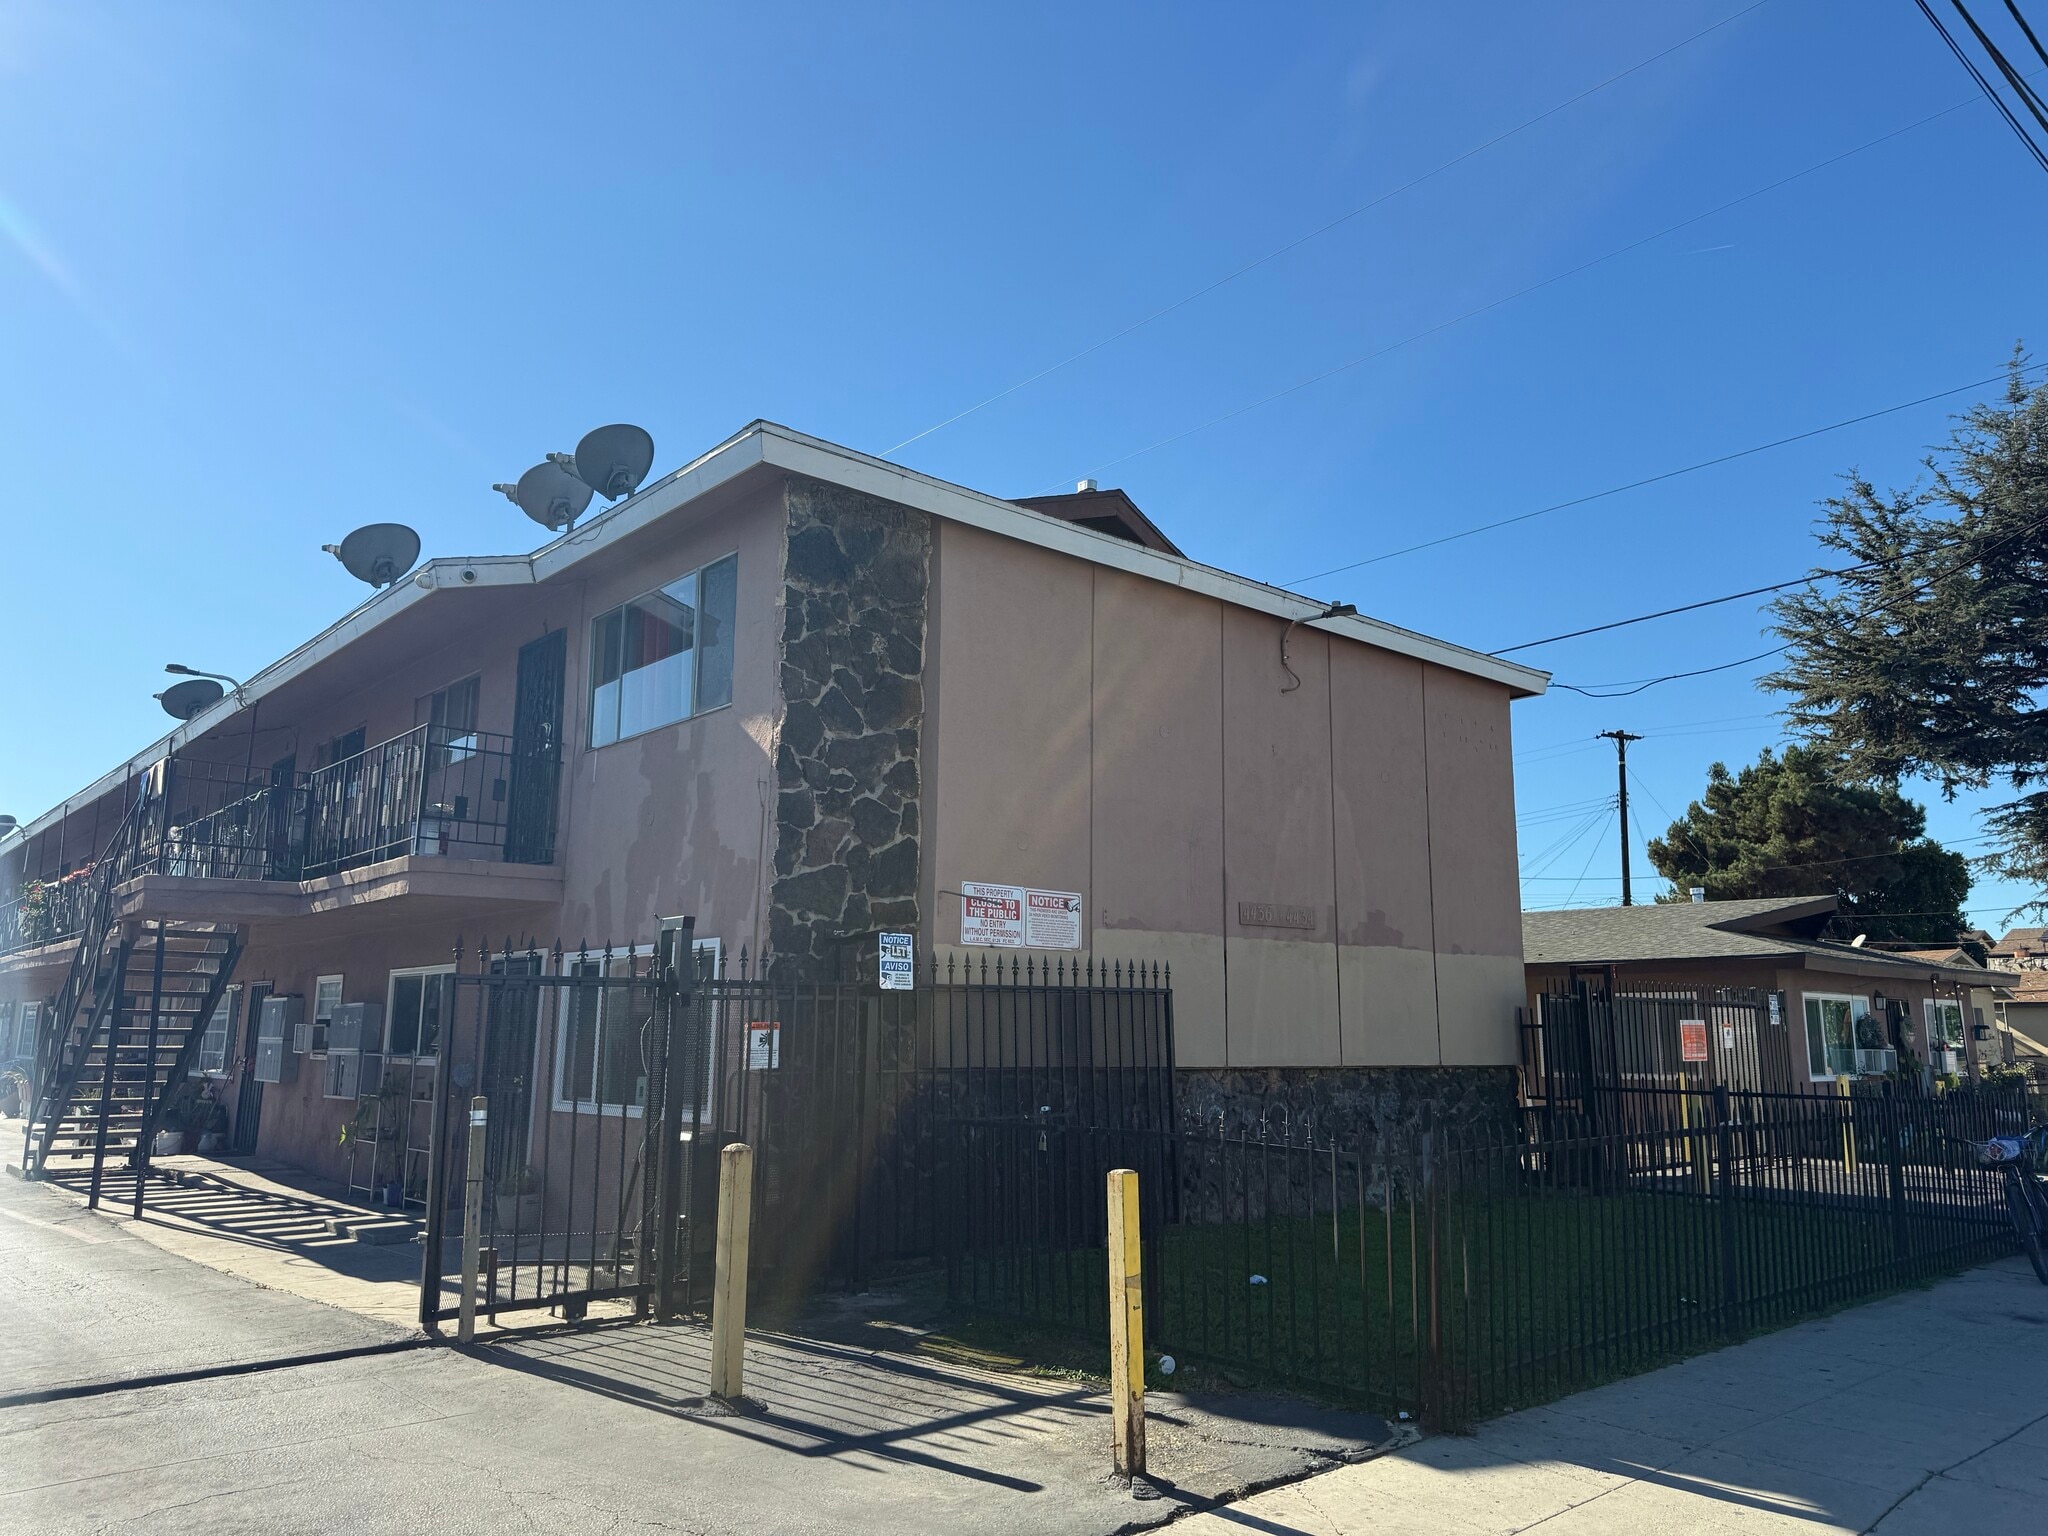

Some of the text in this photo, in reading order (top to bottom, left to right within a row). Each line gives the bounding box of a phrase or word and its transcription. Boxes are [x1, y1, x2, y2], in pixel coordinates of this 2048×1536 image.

[973, 887, 1014, 898] THIS PROPERTY
[970, 897, 1015, 910] CLOSED TO
[1032, 896, 1064, 908] NOTICE
[969, 907, 1016, 920] THE PUBLIC
[980, 920, 1006, 928] NO ENTRY
[965, 926, 1020, 938] WITHOUT PERMISSION
[883, 936, 909, 944] NOTICE
[892, 946, 906, 956] LET
[885, 962, 908, 970] AVISO
